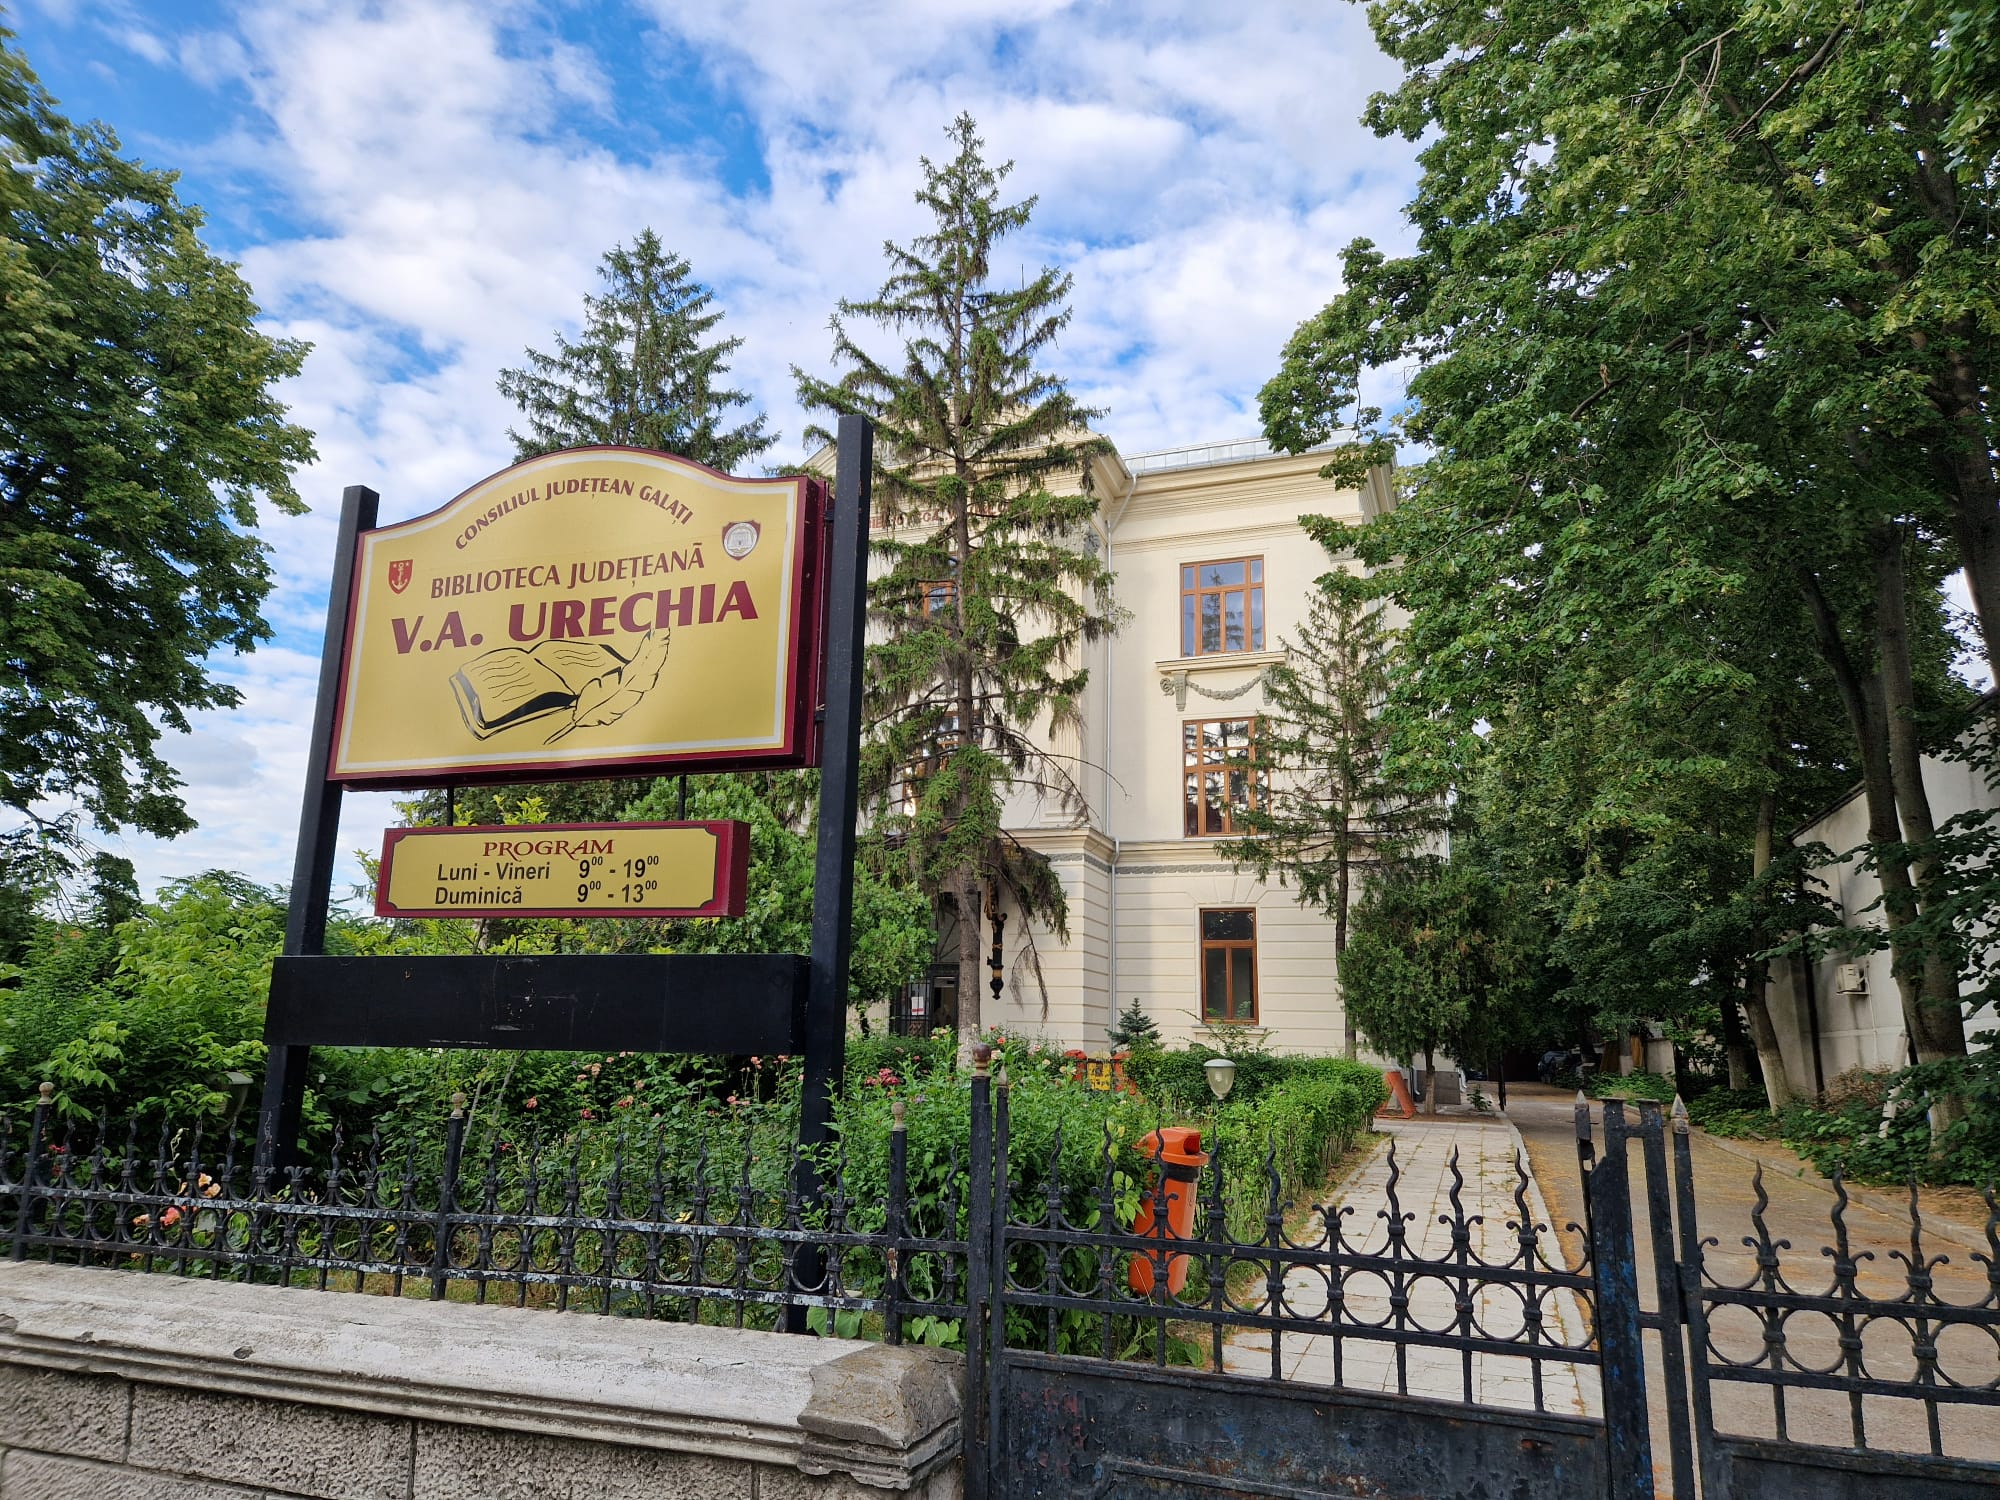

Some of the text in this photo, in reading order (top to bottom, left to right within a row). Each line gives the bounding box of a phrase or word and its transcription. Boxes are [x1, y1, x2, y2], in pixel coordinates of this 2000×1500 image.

[455, 477, 693, 550] CONSILIUL JUDEȚEAN GALAȚI
[430, 564, 560, 599] BIBLIOTECA
[391, 580, 759, 654] V.A. URECHIA
[483, 839, 614, 862] PROGRAM
[437, 863, 478, 881] Luni
[496, 861, 550, 880] Vineri
[434, 886, 522, 905] Duminică
